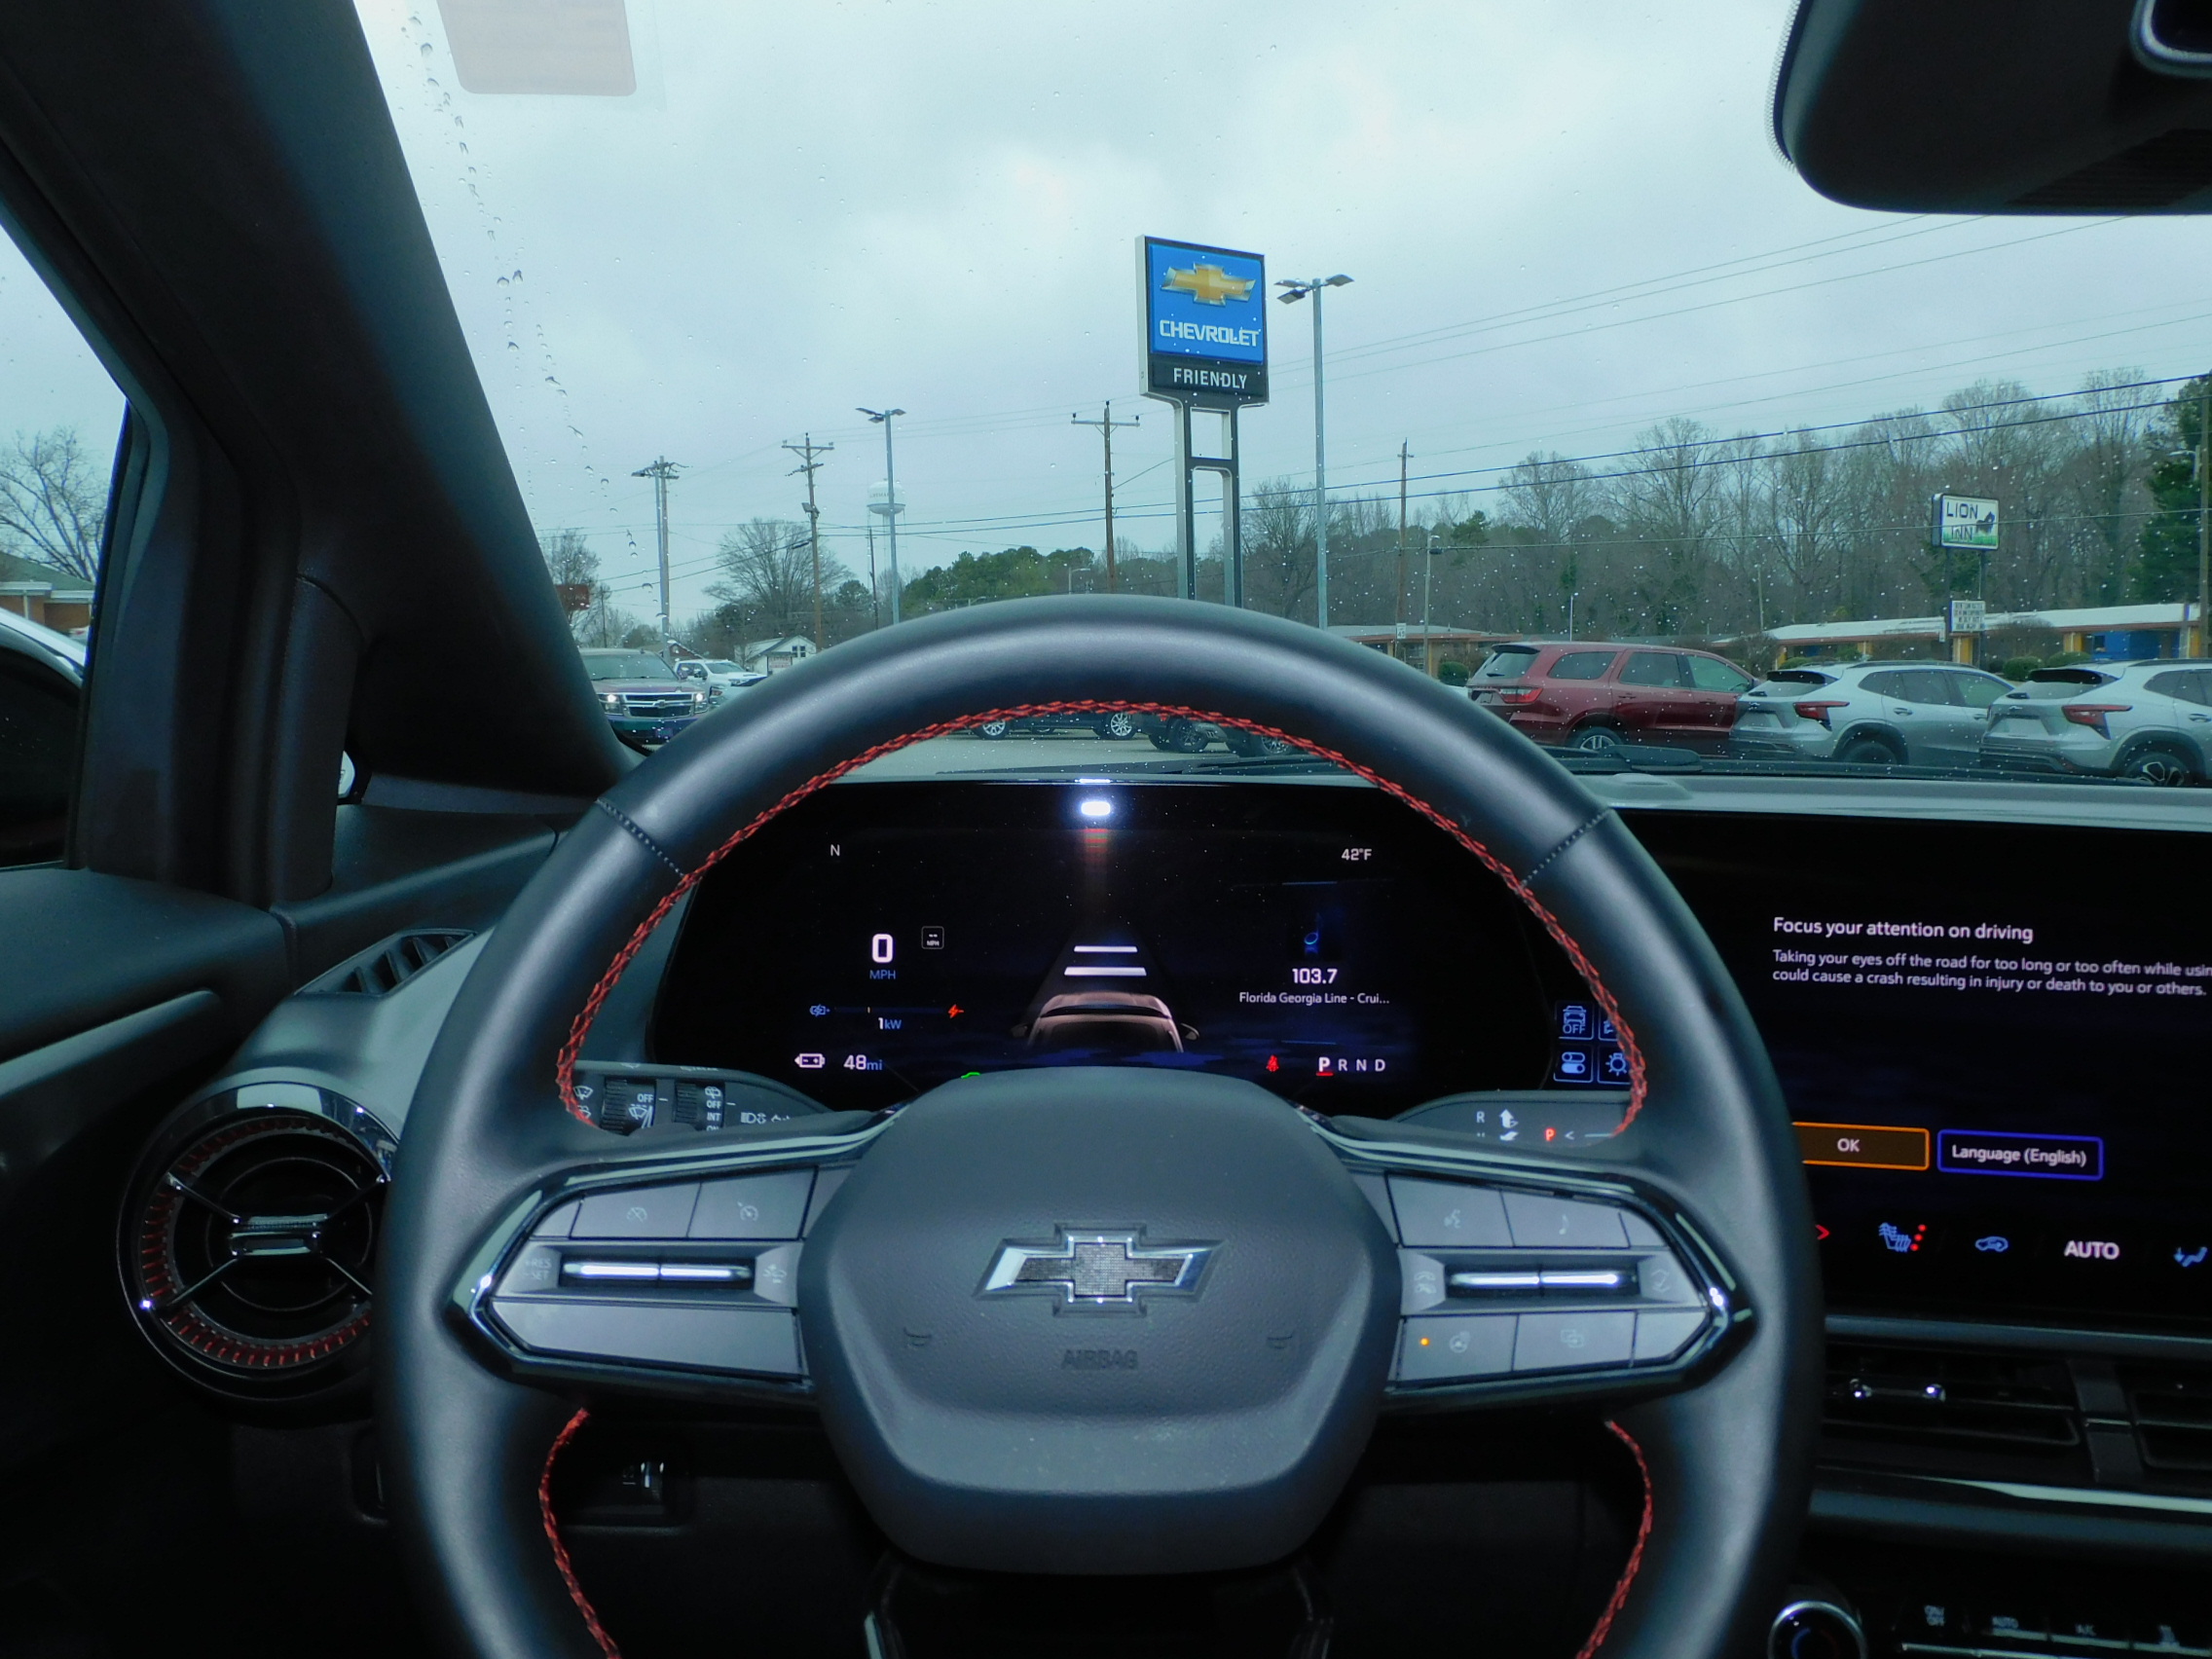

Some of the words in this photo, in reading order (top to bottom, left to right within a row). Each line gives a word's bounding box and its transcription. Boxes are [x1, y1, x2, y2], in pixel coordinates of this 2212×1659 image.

[1160, 319, 1260, 347] CHEVROLET
[1173, 367, 1247, 389] FRIENDLY
[1946, 502, 1978, 520] LION
[830, 844, 839, 856] N
[1342, 848, 1372, 861] 42°F
[1774, 917, 1823, 934] Focus
[1825, 923, 1862, 938] your
[1866, 922, 1944, 937] attention
[1948, 927, 1971, 938] on
[1974, 923, 2033, 944] driving
[872, 934, 893, 963] 0
[1773, 949, 1816, 967] Taking
[1819, 954, 1848, 967] your
[1852, 955, 1883, 968] eyes
[1886, 953, 1906, 966] off
[1909, 954, 1932, 967] the
[1936, 956, 1967, 968] road
[1971, 955, 1991, 969] for
[1994, 958, 2018, 970] too
[2021, 958, 2052, 975] long
[2055, 963, 2071, 972] or
[2075, 961, 2099, 973] too
[2102, 960, 2141, 974] often
[2144, 962, 2182, 976] while
[870, 970, 896, 979] MPH
[1292, 968, 1338, 983] 103.7
[1773, 969, 1809, 981] could
[1812, 973, 1852, 982] cause
[1855, 974, 1863, 982] a
[1866, 972, 1903, 984] crash
[1907, 974, 1966, 990] resulting
[1970, 976, 1981, 986] in
[1986, 977, 2024, 992] injury
[2027, 980, 2043, 989] or
[2046, 977, 2085, 991] death
[2089, 980, 2105, 992] to
[2108, 983, 2133, 995] you
[2136, 984, 2153, 993] or
[2156, 981, 2206, 995] others.
[1239, 992, 1276, 1003] Florida
[1279, 992, 1322, 1006] Georgia
[1325, 993, 1346, 1003] Line
[1357, 993, 1389, 1004] Crui...
[1563, 1024, 1586, 1034] OFF
[1319, 1057, 1330, 1071] P
[1339, 1059, 1347, 1071] R
[1356, 1059, 1367, 1071] N
[1375, 1059, 1385, 1071] D
[637, 1093, 653, 1102] OFF
[706, 1100, 721, 1109] OFF
[707, 1112, 720, 1122] INT
[1476, 1112, 1485, 1124] R
[1545, 1128, 1555, 1141] P
[1837, 1138, 1860, 1152] OK
[1952, 1145, 2021, 1163] Language
[2024, 1148, 2086, 1166] (English)
[2064, 1240, 2120, 1260] AUTO
[1060, 1348, 1138, 1371] AIRBAG
